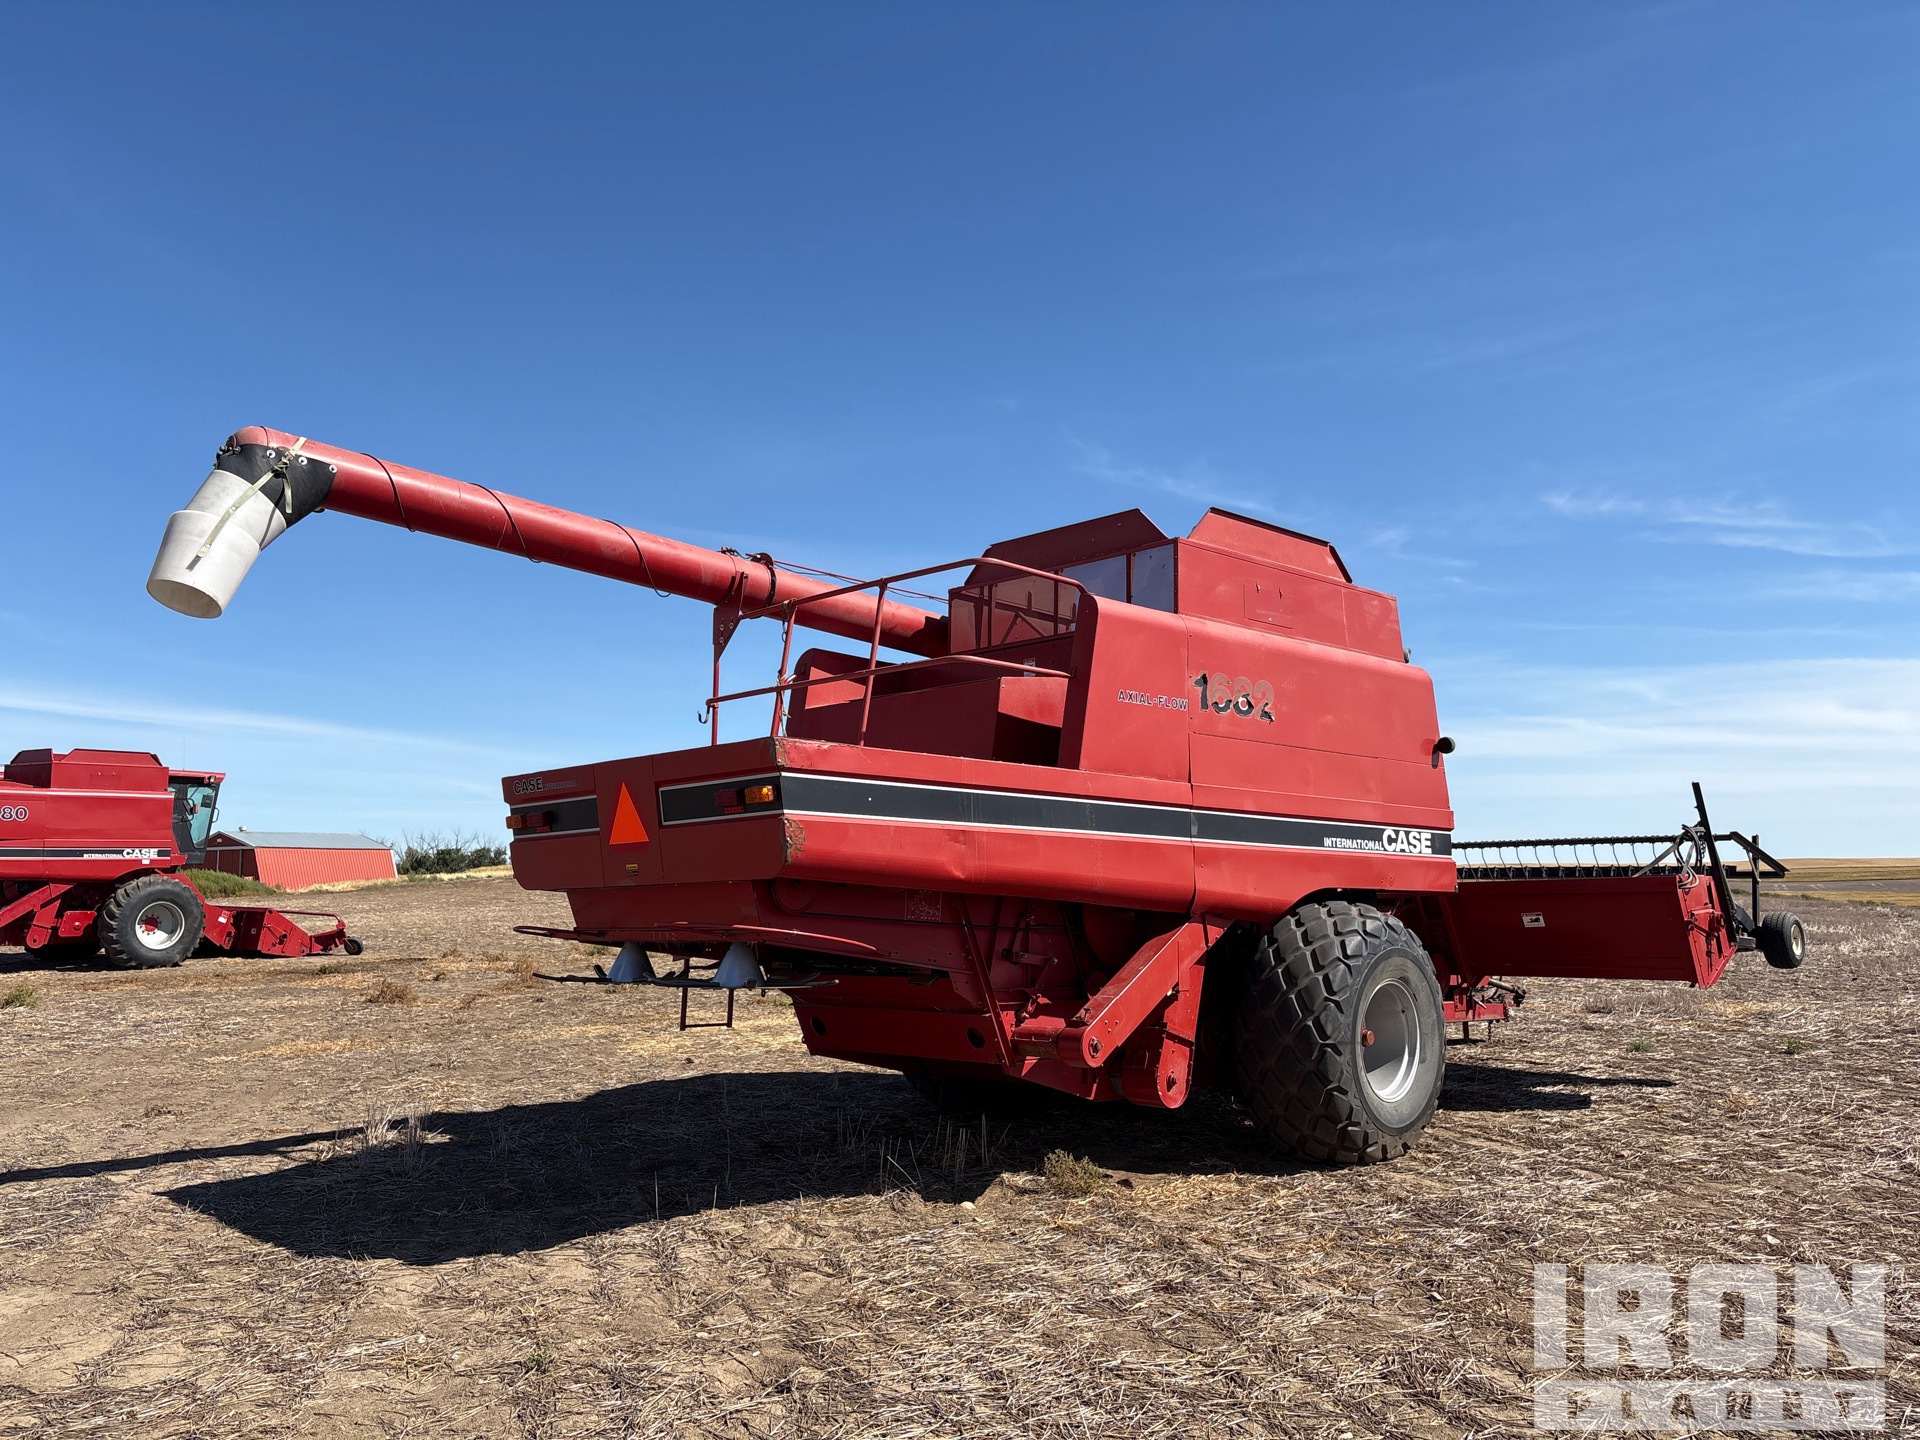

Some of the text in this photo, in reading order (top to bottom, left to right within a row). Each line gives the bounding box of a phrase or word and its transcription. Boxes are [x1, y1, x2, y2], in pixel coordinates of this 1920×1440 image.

[1117, 688, 1188, 712] AXIAL-FLOW
[1193, 671, 1276, 723] 1682
[513, 777, 543, 794] CASE
[0, 805, 29, 822] 80
[1323, 828, 1433, 854] INTERNATIONAL CASE
[122, 848, 158, 858] CASE
